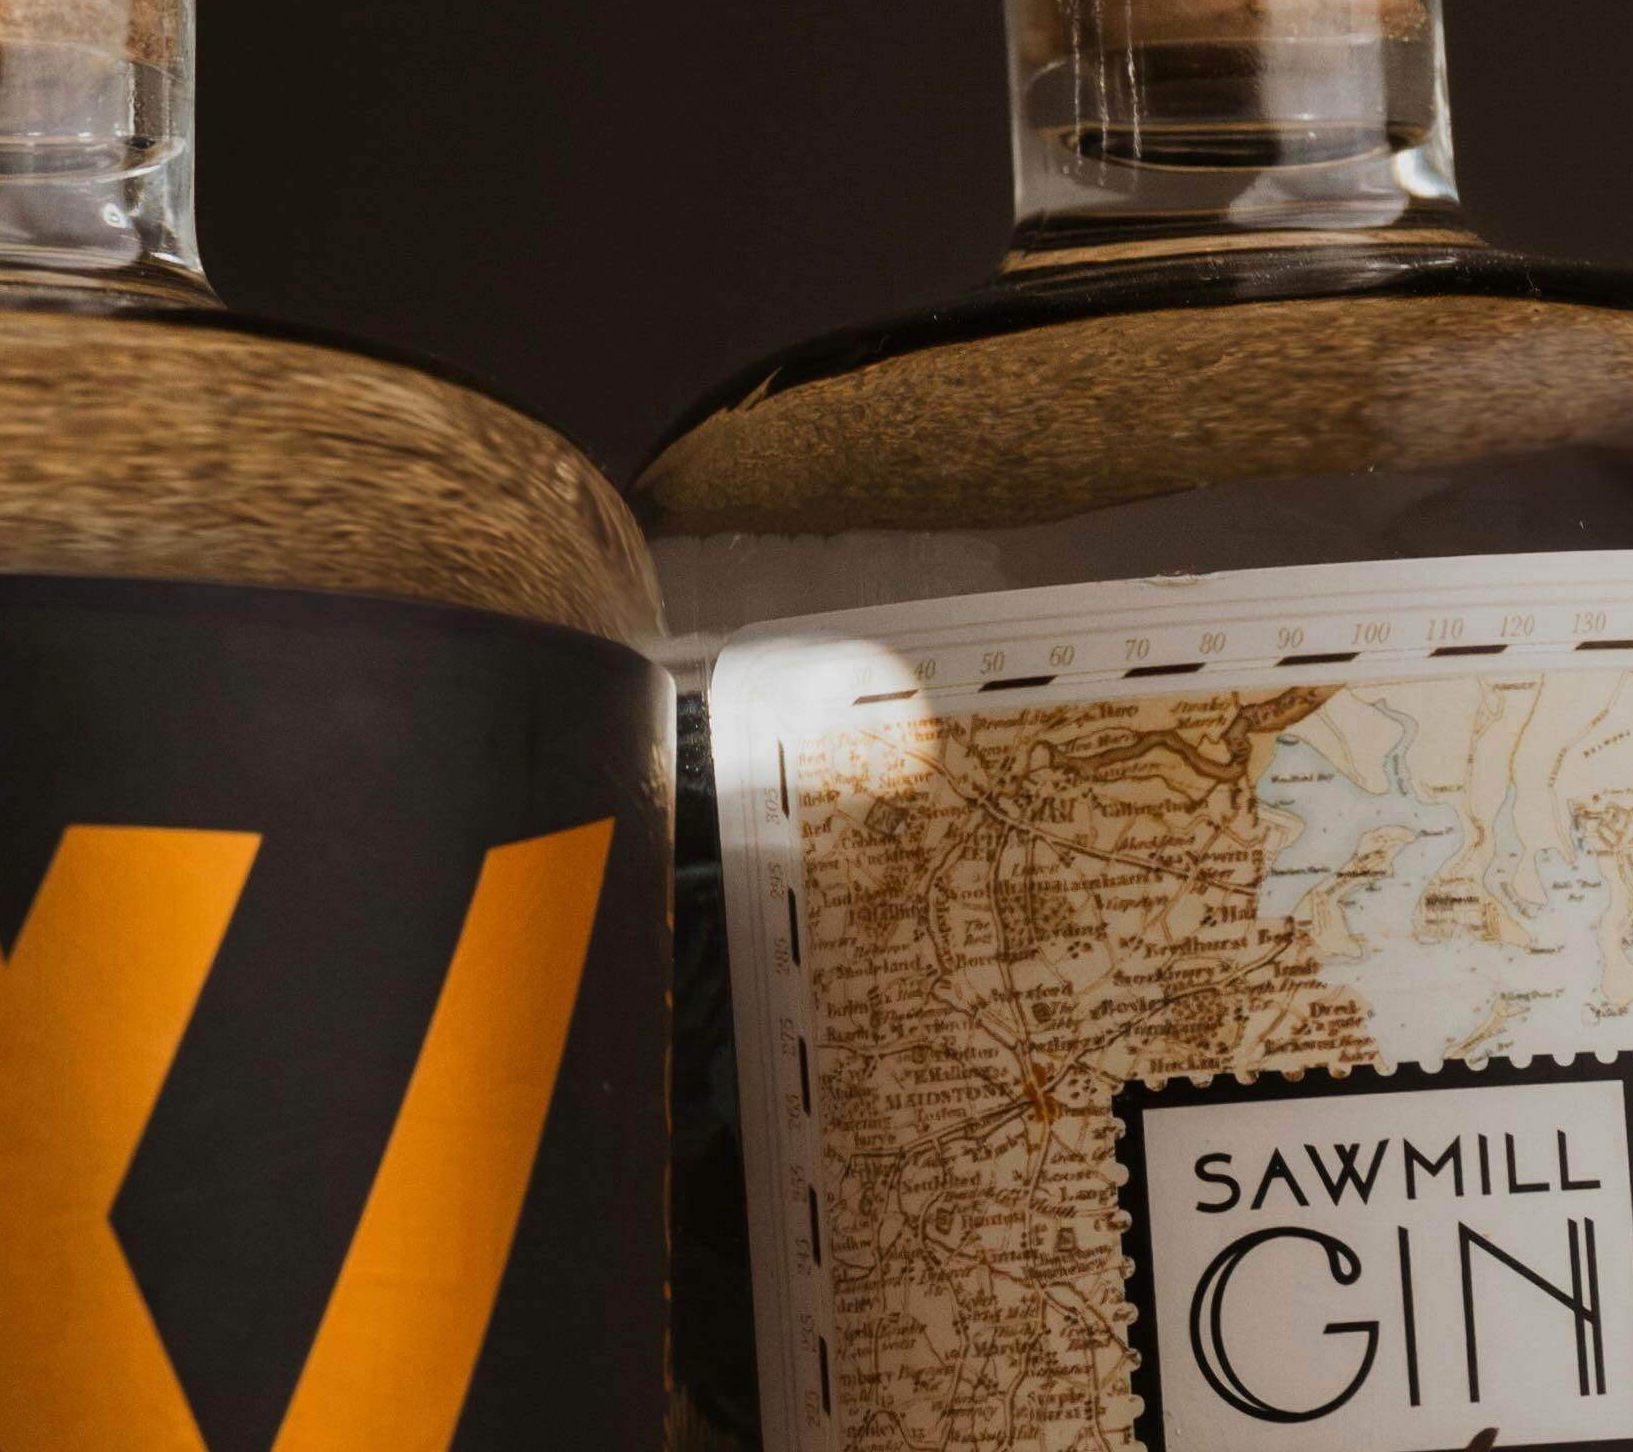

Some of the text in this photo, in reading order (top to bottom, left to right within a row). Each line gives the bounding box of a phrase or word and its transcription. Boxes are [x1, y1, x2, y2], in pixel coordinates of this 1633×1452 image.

[913, 658, 937, 680] 40
[979, 651, 1005, 675] 50
[1048, 644, 1076, 667] 60
[1123, 637, 1150, 661] 70
[1197, 631, 1226, 655] 80
[1276, 626, 1304, 650] 90
[1351, 621, 1391, 645] 100
[1425, 617, 1464, 642] 110
[1499, 614, 1536, 638] 120
[1572, 611, 1606, 634] 130
[1195, 1129, 1601, 1213] SAWMILL
[1190, 1216, 1607, 1424] GIN
